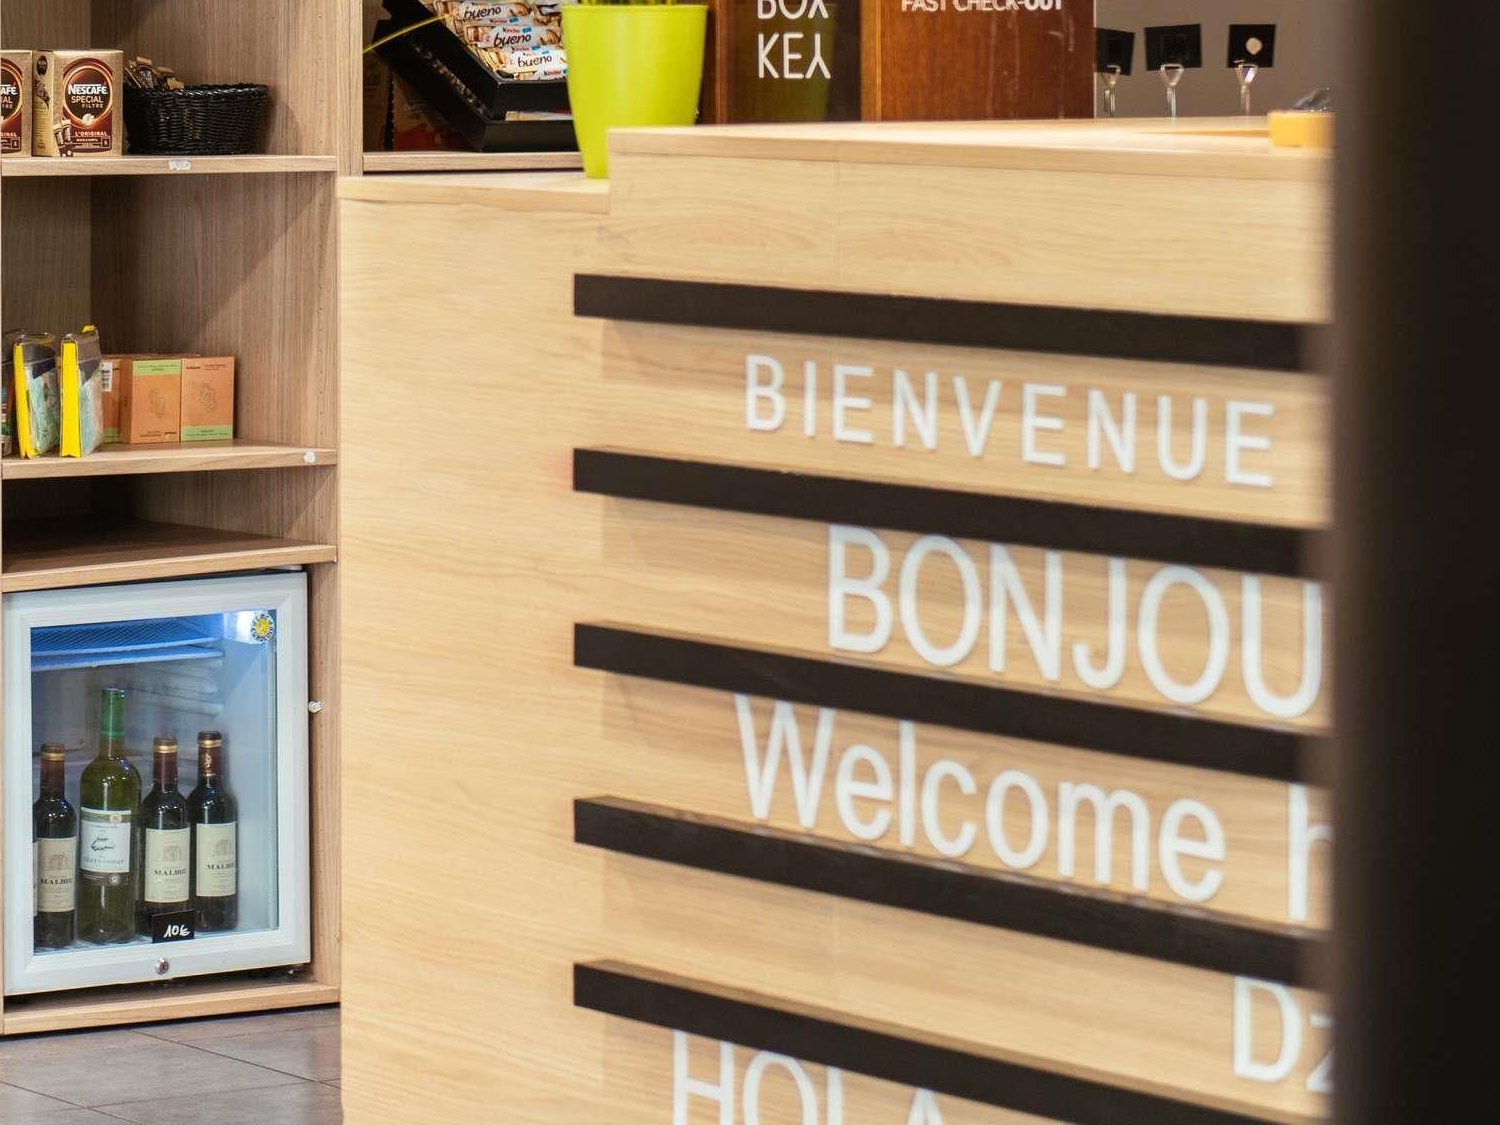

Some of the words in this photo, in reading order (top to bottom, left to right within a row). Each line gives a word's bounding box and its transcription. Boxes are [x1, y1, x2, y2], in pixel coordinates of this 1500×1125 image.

[464, 6, 501, 19] bueno
[494, 33, 532, 47] bueno
[518, 55, 553, 68] bueno
[744, 354, 1275, 487] BIENVENUE
[827, 524, 1323, 719] BONJOU
[734, 692, 1227, 903] Welcome
[163, 924, 191, 938] 10€
